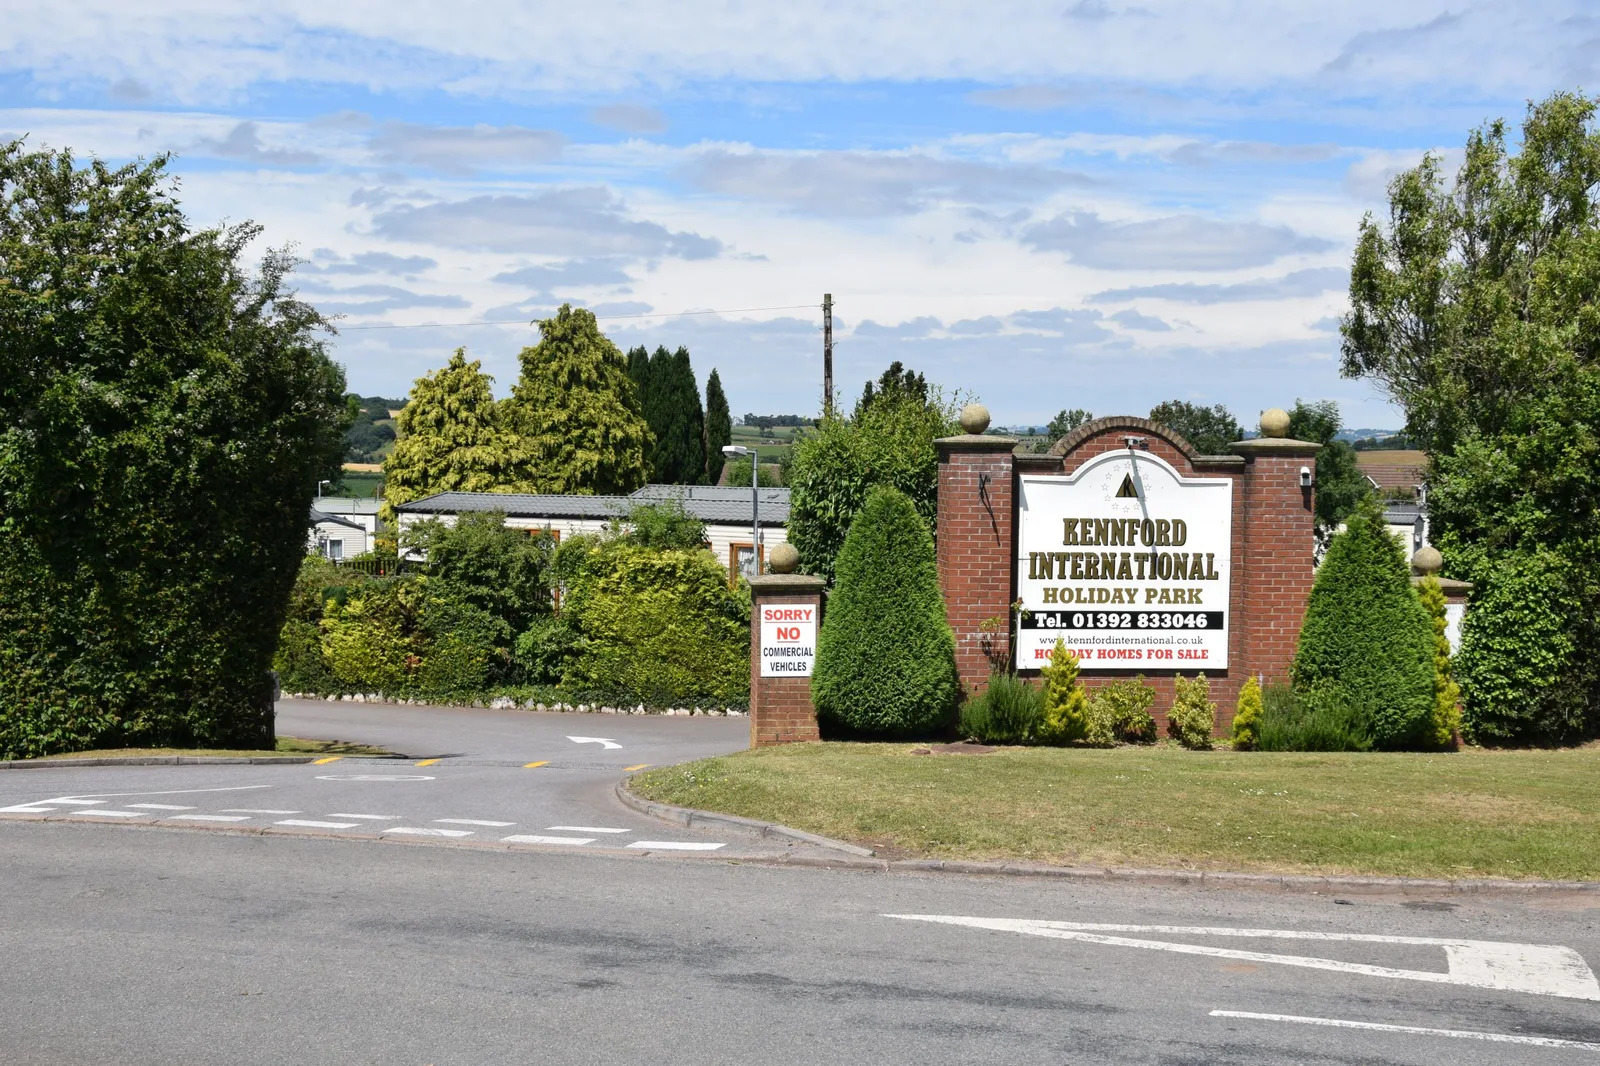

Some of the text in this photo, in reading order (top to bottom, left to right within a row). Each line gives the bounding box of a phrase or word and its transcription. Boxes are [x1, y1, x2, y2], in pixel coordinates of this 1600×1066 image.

[1063, 518, 1187, 546] KENNFORD
[1028, 552, 1219, 580] INTERNATIONAL
[1043, 587, 1203, 604] HOLIDAY PARK
[764, 609, 812, 621] SORRY
[1035, 613, 1208, 628] Tel. 01392 833046
[777, 627, 801, 640] NO
[763, 647, 813, 657] COMMERCIAL
[1034, 649, 1209, 660] HODAY HOMES FOR SALE
[770, 661, 807, 671] VEHICLES
